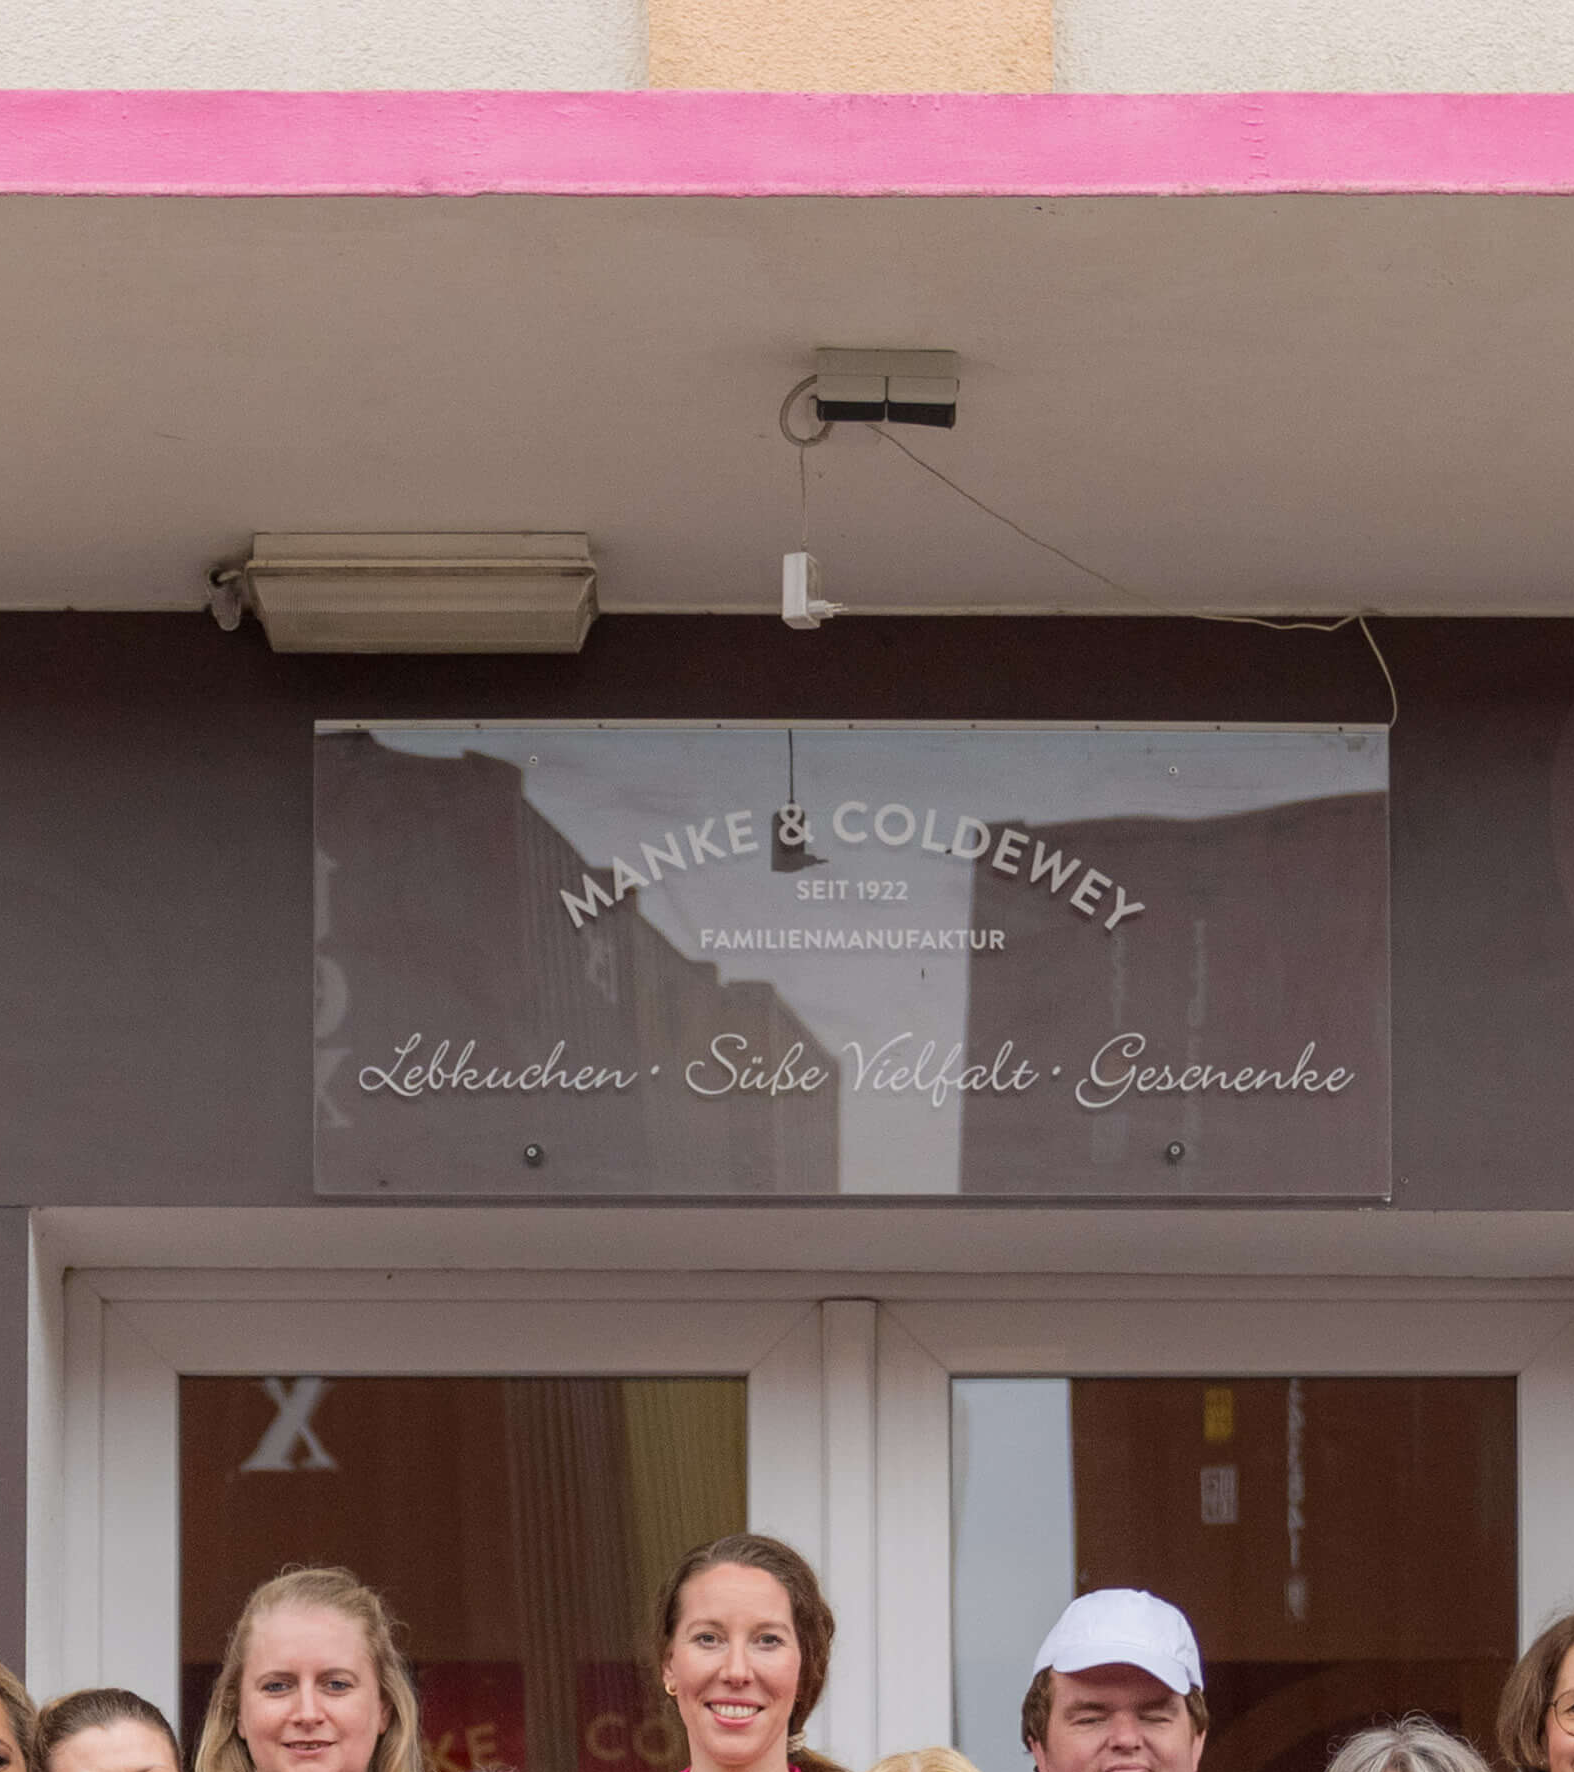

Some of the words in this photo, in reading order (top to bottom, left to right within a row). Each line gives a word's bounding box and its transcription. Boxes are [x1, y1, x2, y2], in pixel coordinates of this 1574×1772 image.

[559, 809, 760, 929] MANKE
[778, 803, 815, 846] &
[832, 800, 1146, 931] COLDEWEY
[796, 880, 849, 900] SEIT
[857, 880, 908, 900] 1922
[700, 929, 1006, 950] FAMILIENMANUFAKTUR
[359, 1032, 638, 1097] Lebkuchen
[685, 1033, 829, 1096] Süße
[841, 1031, 1040, 1107] Vielfalt
